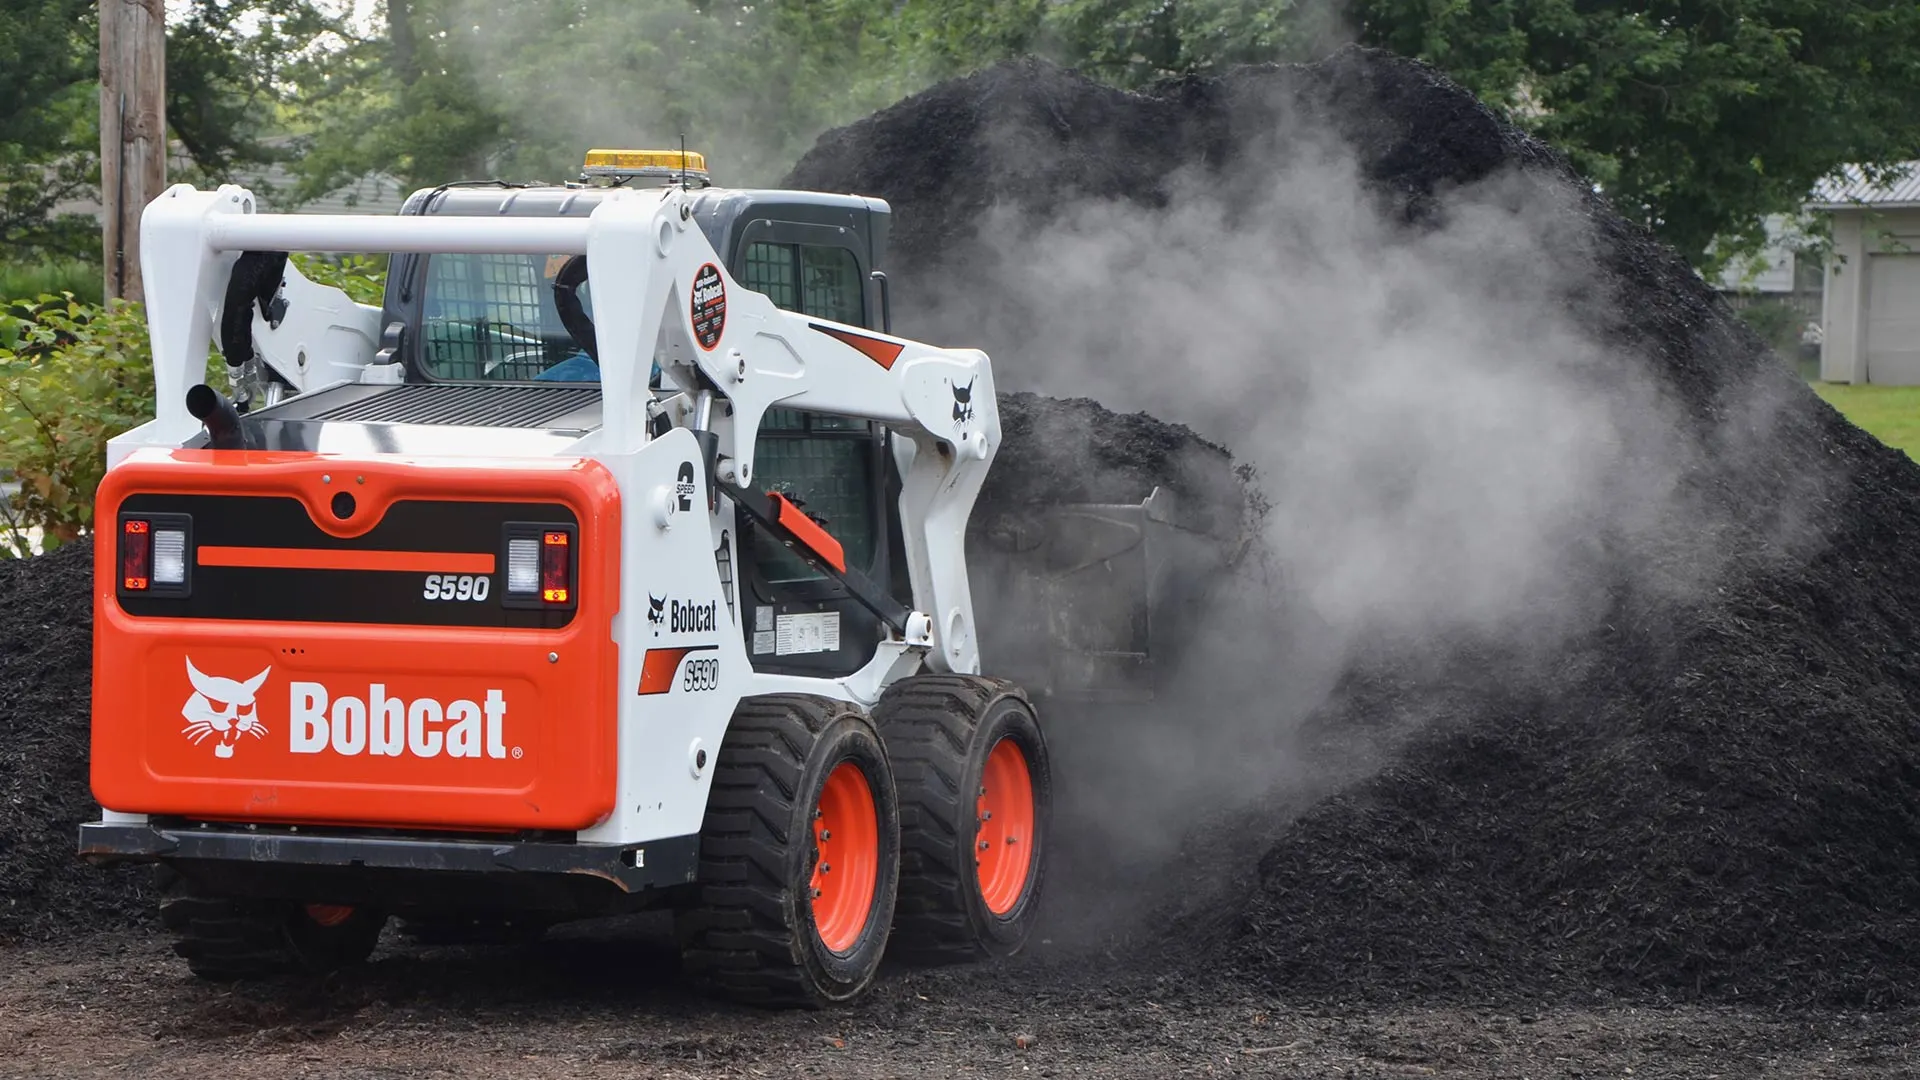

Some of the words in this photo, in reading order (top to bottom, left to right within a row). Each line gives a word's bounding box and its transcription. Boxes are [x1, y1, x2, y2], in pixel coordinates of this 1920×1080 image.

[676, 484, 695, 494] SPEED
[423, 574, 490, 602] S590
[671, 599, 716, 633] Bobcat
[684, 658, 719, 692] S590
[290, 681, 507, 759] Bobcat
